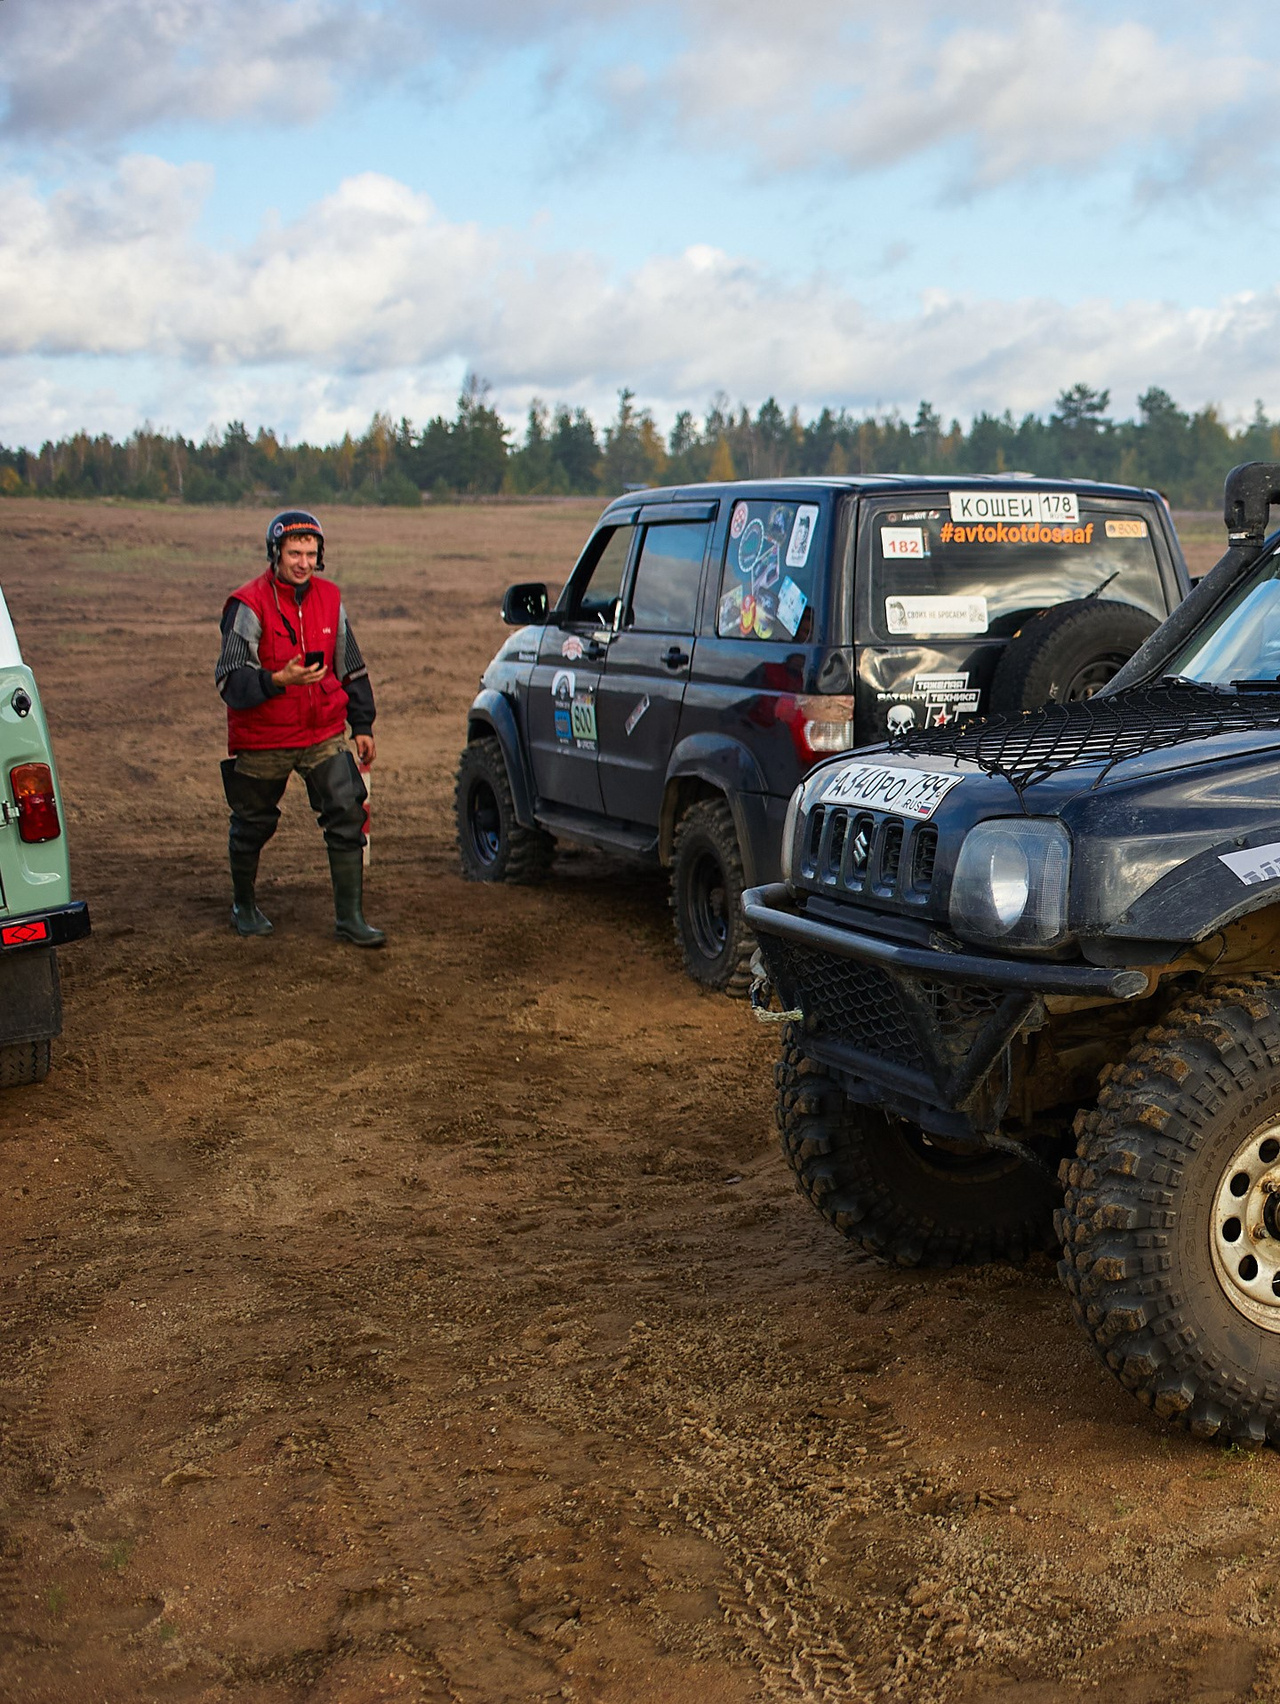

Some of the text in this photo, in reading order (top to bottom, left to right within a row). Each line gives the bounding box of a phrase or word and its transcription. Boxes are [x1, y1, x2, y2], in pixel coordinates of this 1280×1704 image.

[1043, 496, 1072, 512] 178
[940, 522, 1094, 543] #avtokotdosaaf
[889, 540, 919, 553] 182
[931, 692, 976, 702] ТЕХНИКА
[904, 773, 950, 801] 799
[903, 798, 922, 812] RUS
